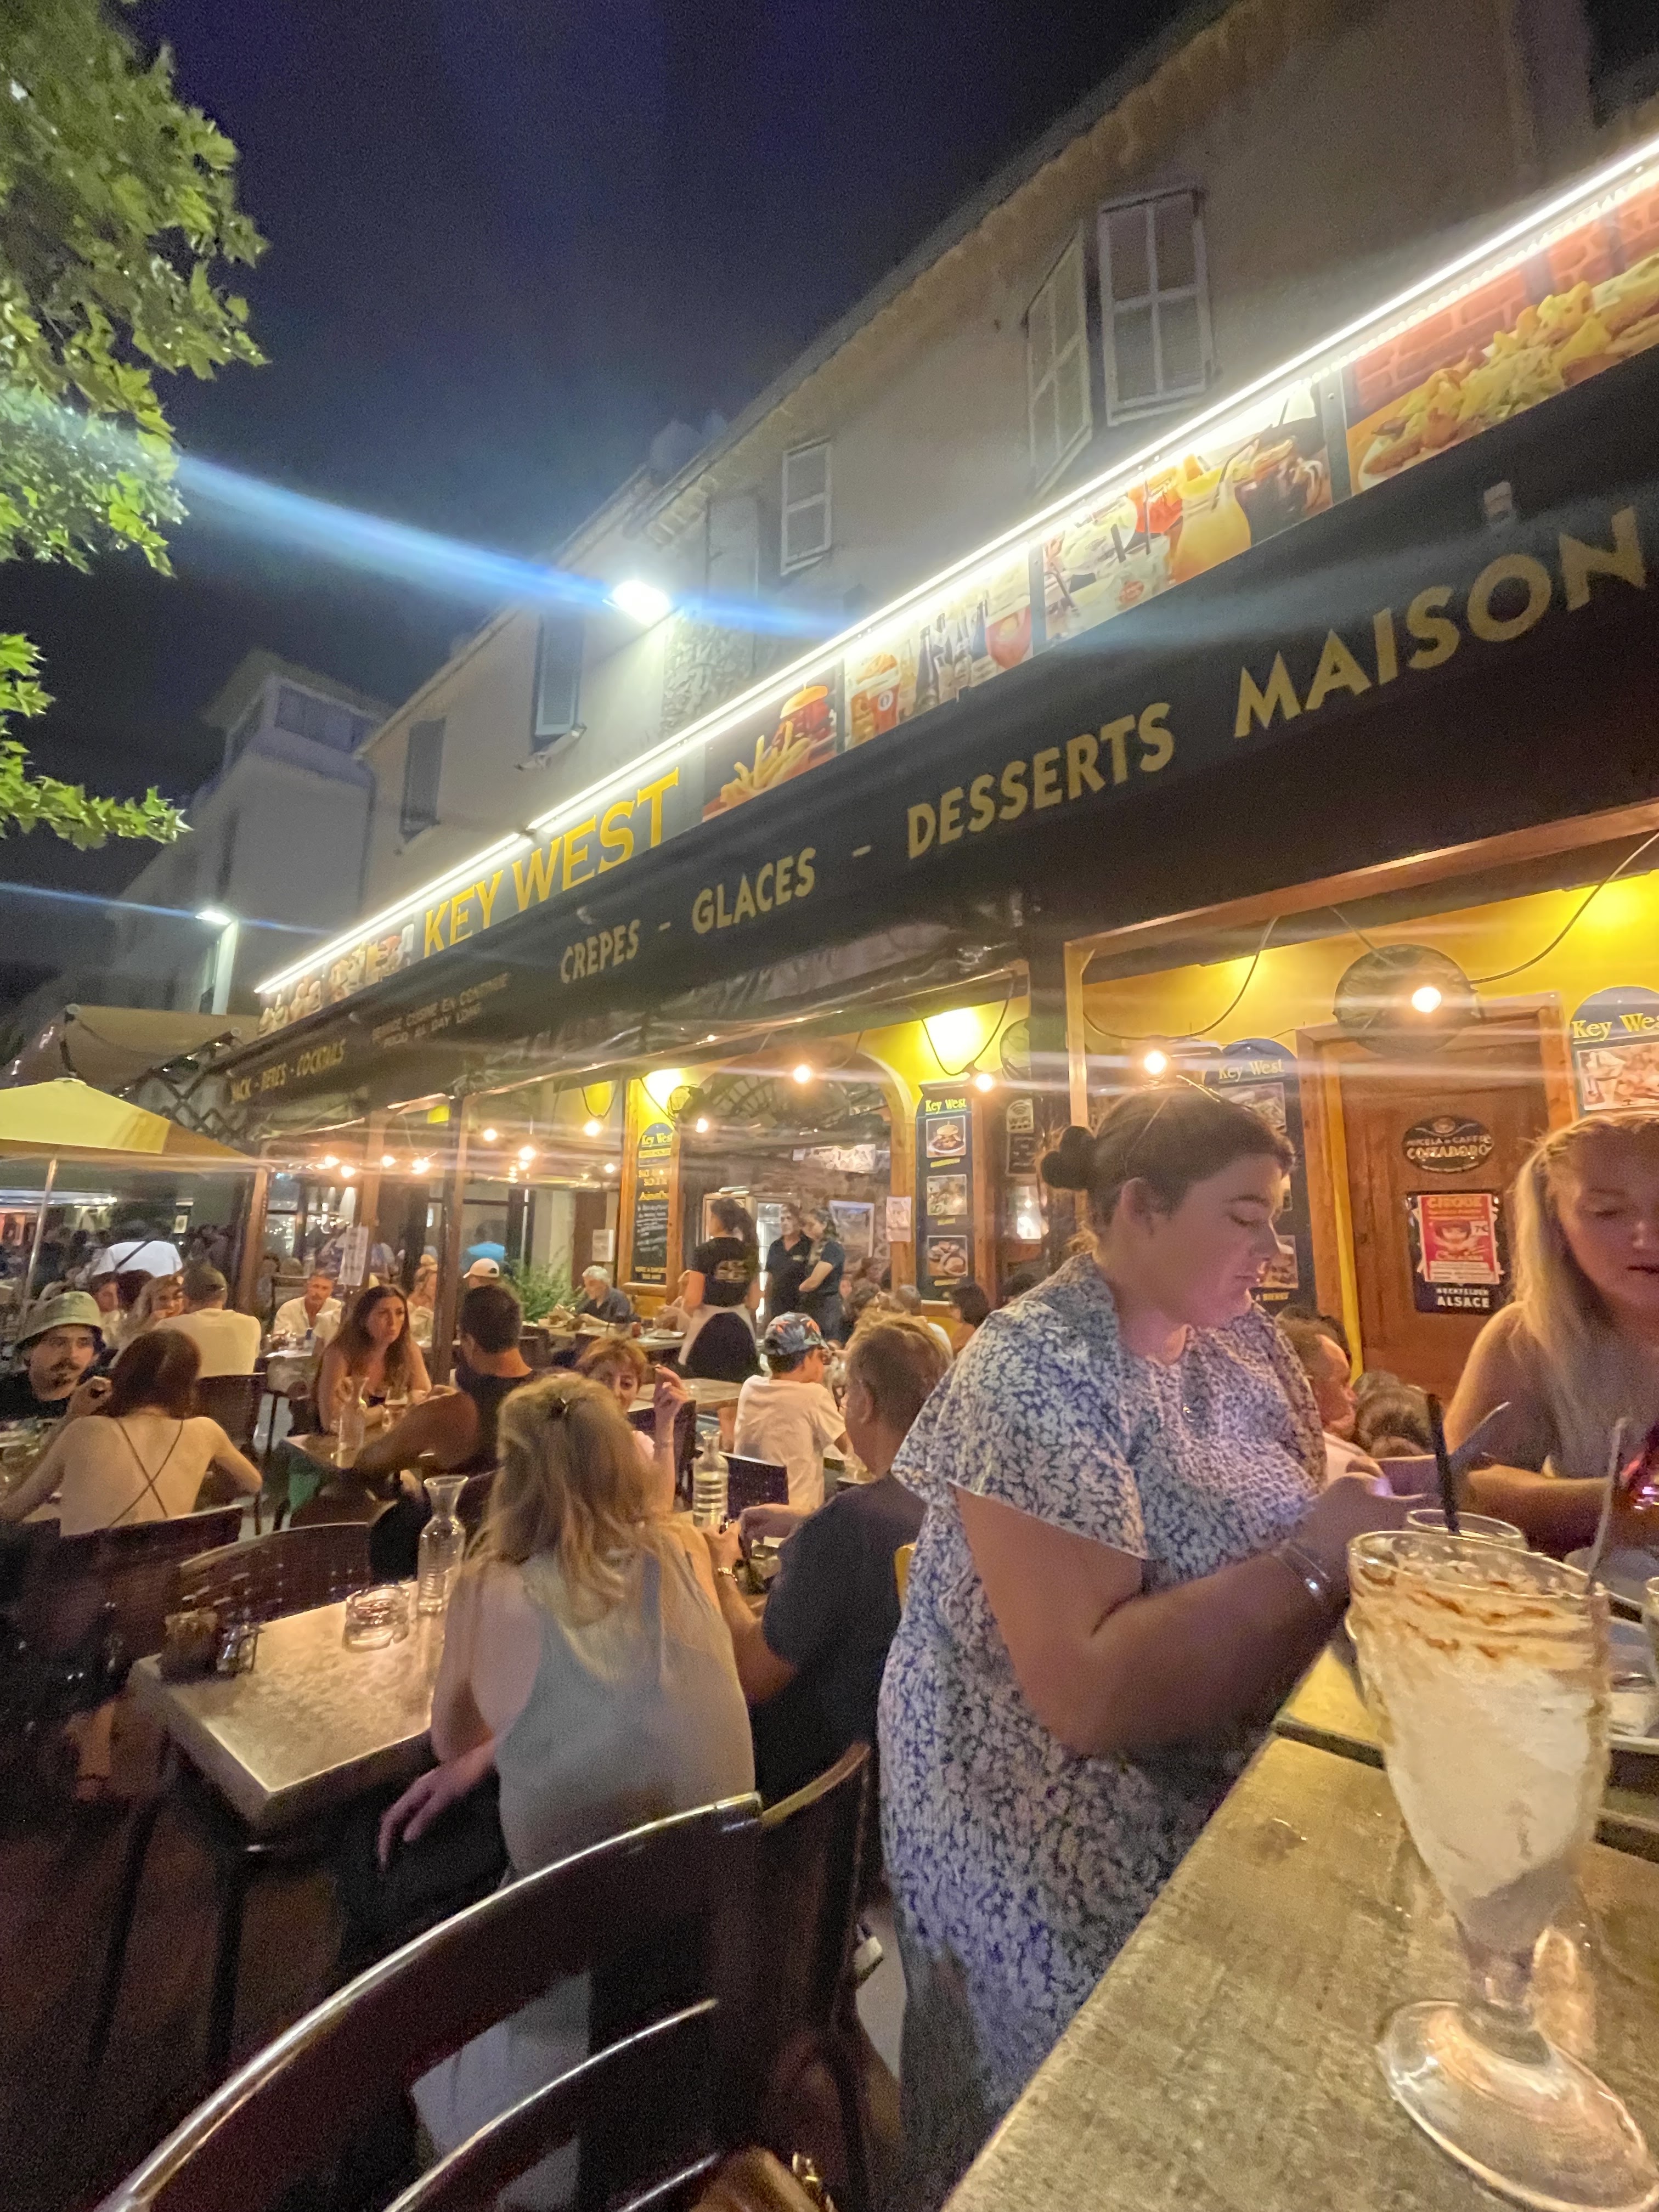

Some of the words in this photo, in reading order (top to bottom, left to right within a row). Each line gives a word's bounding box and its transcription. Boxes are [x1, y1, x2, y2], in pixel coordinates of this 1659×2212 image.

[560, 919, 641, 984] CREPES
[691, 847, 817, 934] GLACES
[907, 702, 1175, 860] DESSERTS
[1234, 505, 1646, 738] MAISON
[424, 870, 504, 958] KEY
[511, 766, 679, 912] WEST
[1571, 1020, 1613, 1041] Key
[1219, 1065, 1244, 1082] Key
[1249, 1059, 1285, 1076] West
[926, 1099, 942, 1114] Key
[945, 1098, 967, 1109] West
[1437, 1296, 1490, 1308] ALSACE
